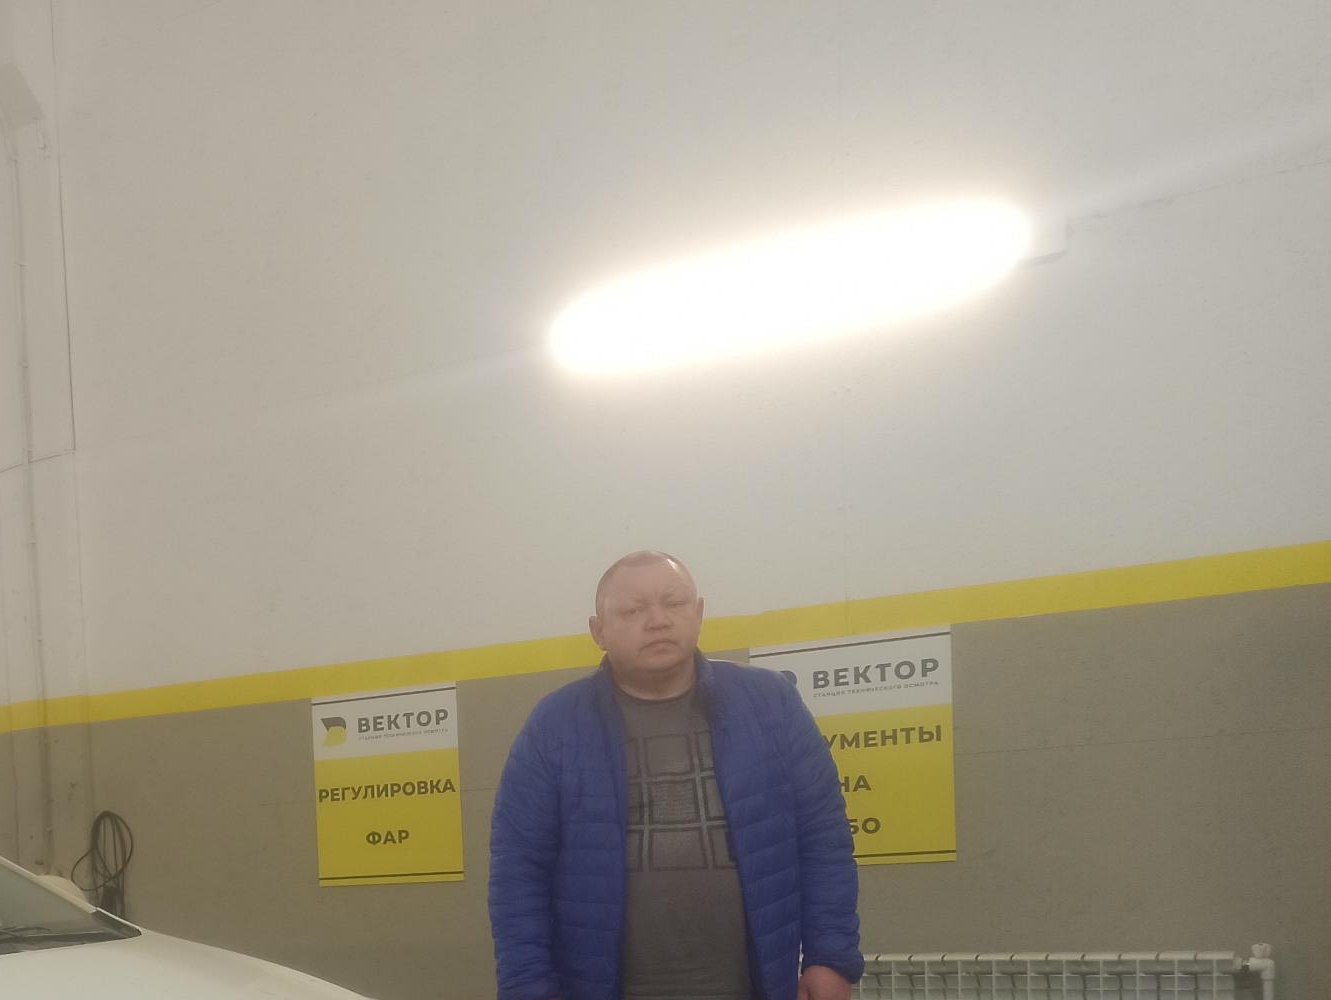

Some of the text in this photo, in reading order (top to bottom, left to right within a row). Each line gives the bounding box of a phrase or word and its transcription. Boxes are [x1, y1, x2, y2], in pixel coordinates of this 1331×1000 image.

[812, 658, 939, 689] ВЕКТОР
[357, 709, 448, 733] ВЕКТОР
[823, 725, 941, 750] УМЕНТЫ
[318, 778, 456, 802] РЕГУЛИРОВКА
[365, 829, 410, 846] ФАР
[846, 817, 881, 835] БО
